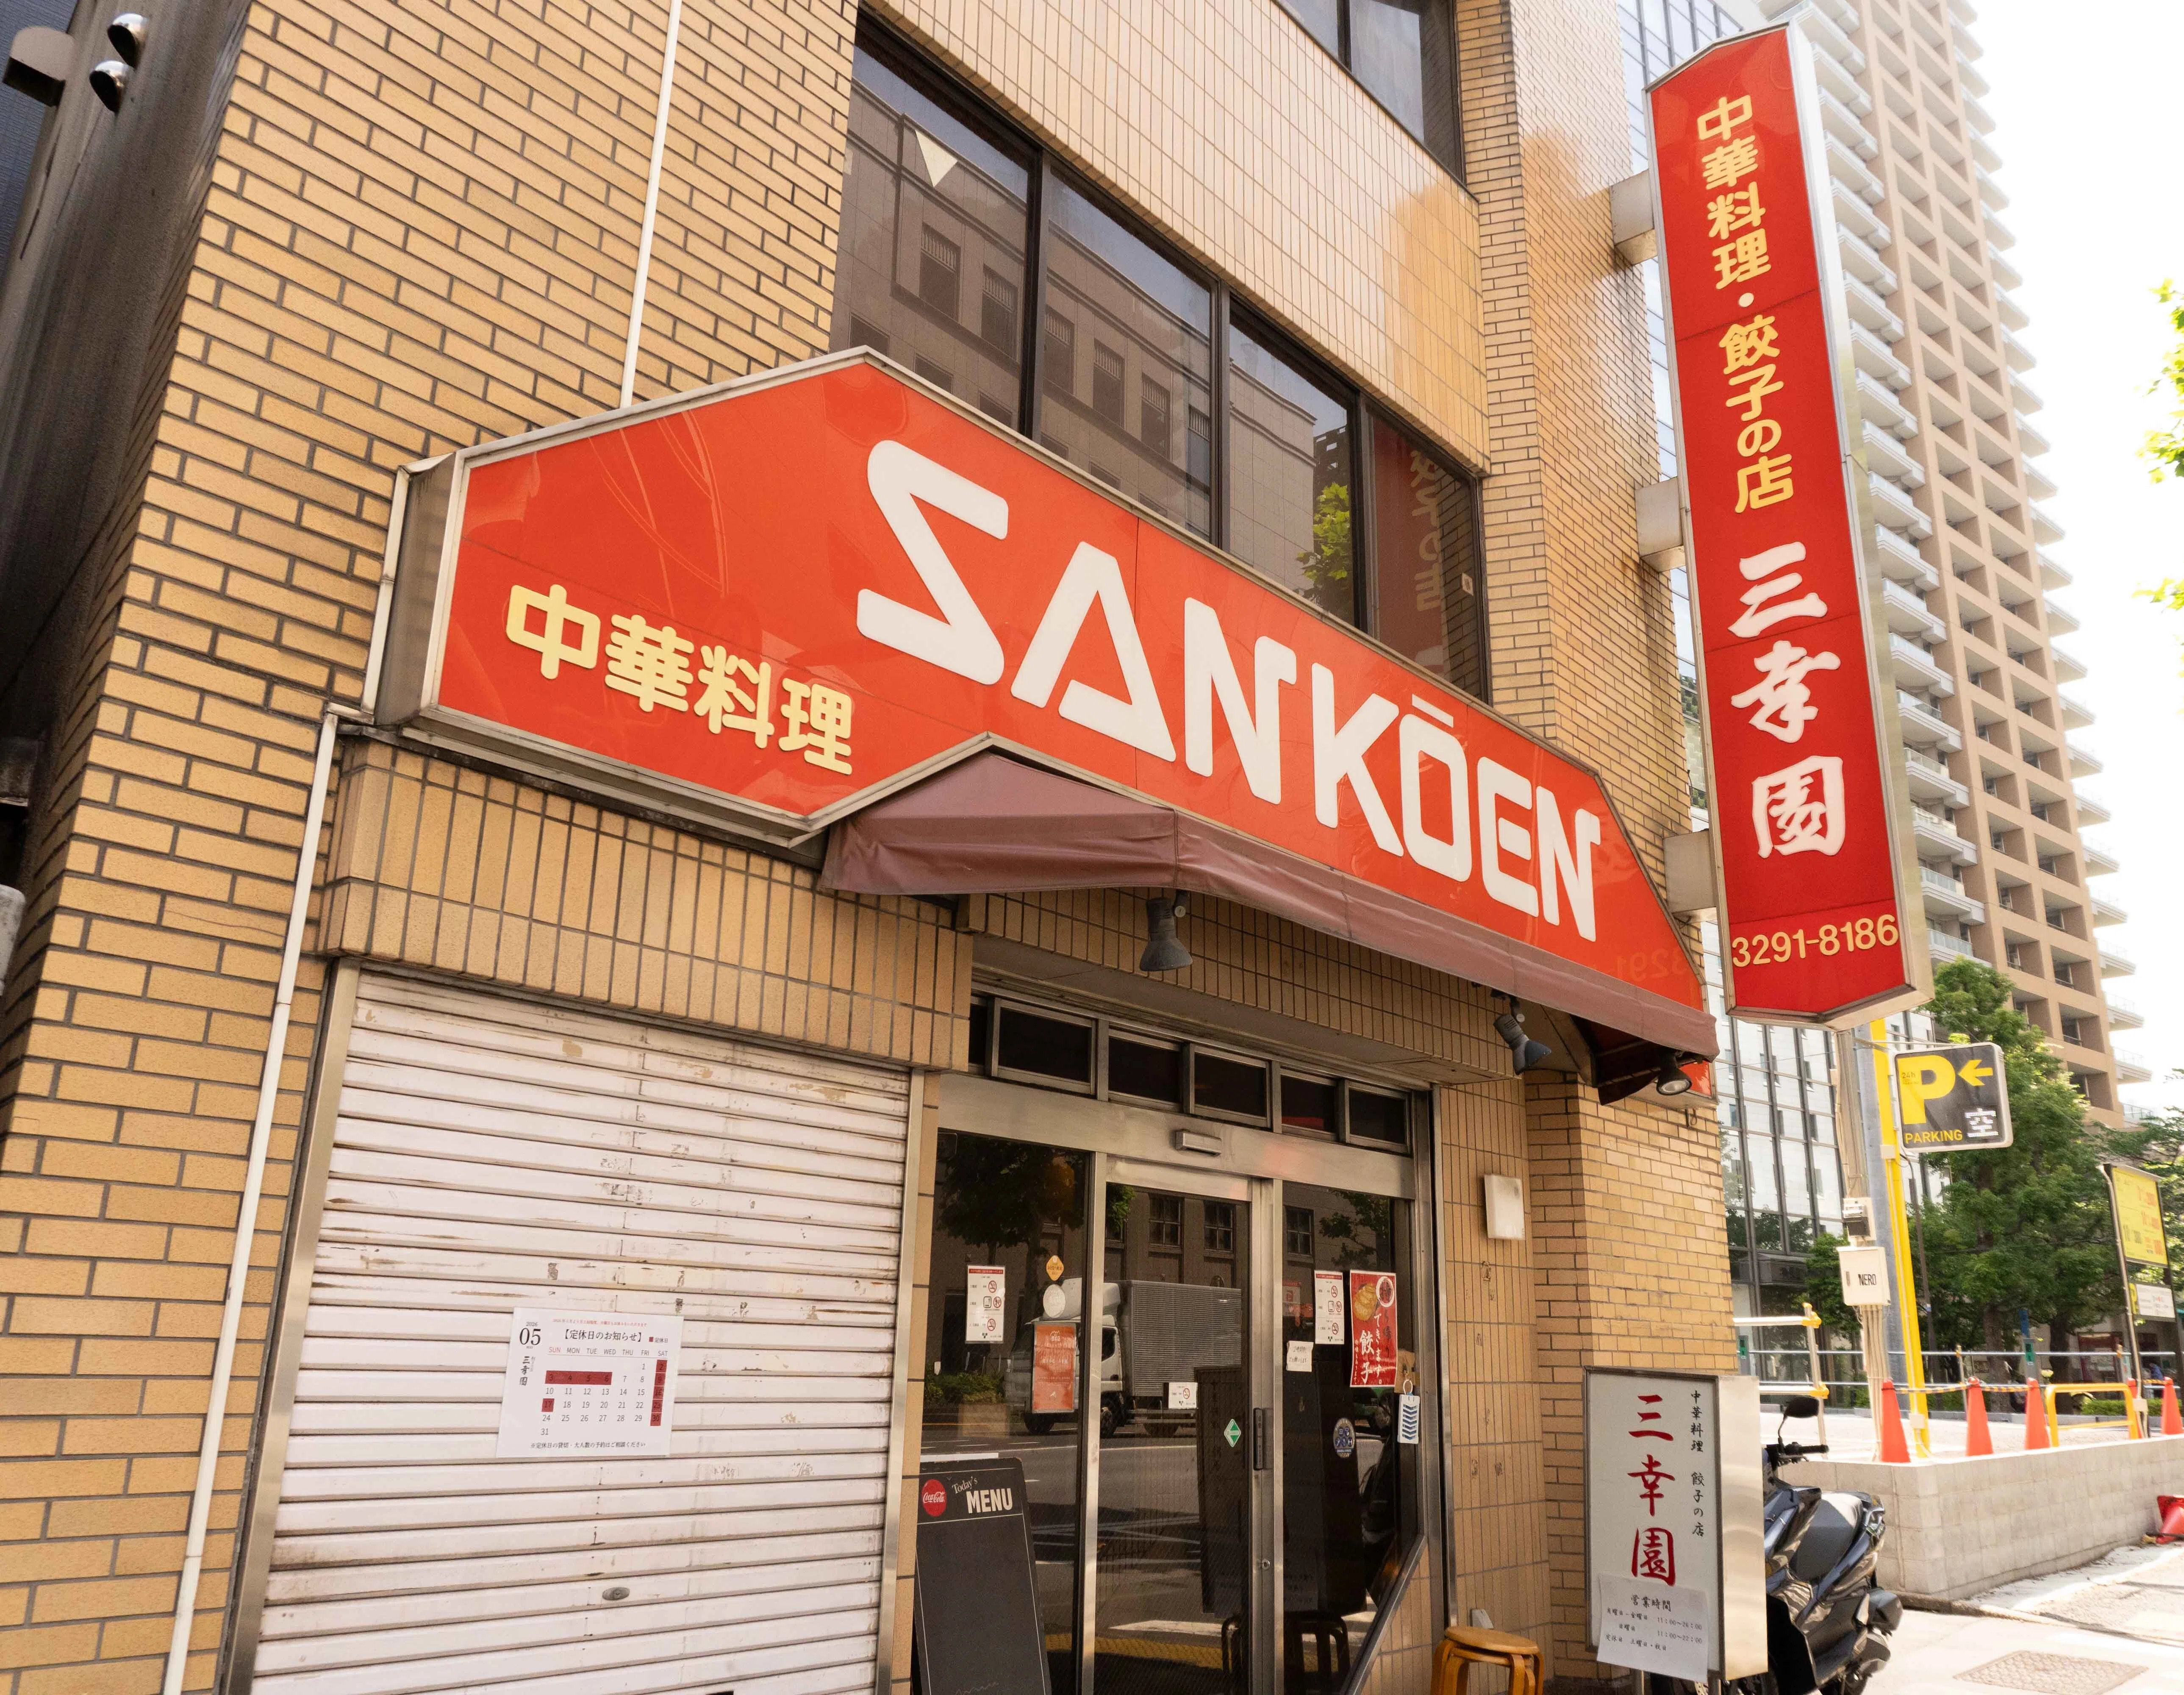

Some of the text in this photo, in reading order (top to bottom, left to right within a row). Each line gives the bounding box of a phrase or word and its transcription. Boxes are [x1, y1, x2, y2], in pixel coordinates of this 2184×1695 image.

[1696, 95, 1794, 514] 中華料理・餃子の店
[505, 584, 852, 775] 中華料理
[1728, 541, 1846, 859] 三幸園
[1732, 914, 1898, 968] 3291-8186
[1965, 1107, 1999, 1138] 空
[1905, 1128, 1963, 1144] PARKING
[1858, 1274, 1877, 1285] NERO
[519, 1328, 541, 1345] 05
[565, 1328, 642, 1342] 【定休日のお知らせ】
[1360, 1329, 1374, 1384] 餃子
[1690, 1390, 1705, 1537] 中華料理 餃子の店
[952, 1476, 978, 1494] Today's
[1627, 1394, 1676, 1587] 三幸園
[966, 1488, 1013, 1514] MENU
[1631, 1595, 1671, 1612] 営業時間
[1606, 1634, 1623, 1642] 定休日
[1619, 1623, 1635, 1631] 日曜日
